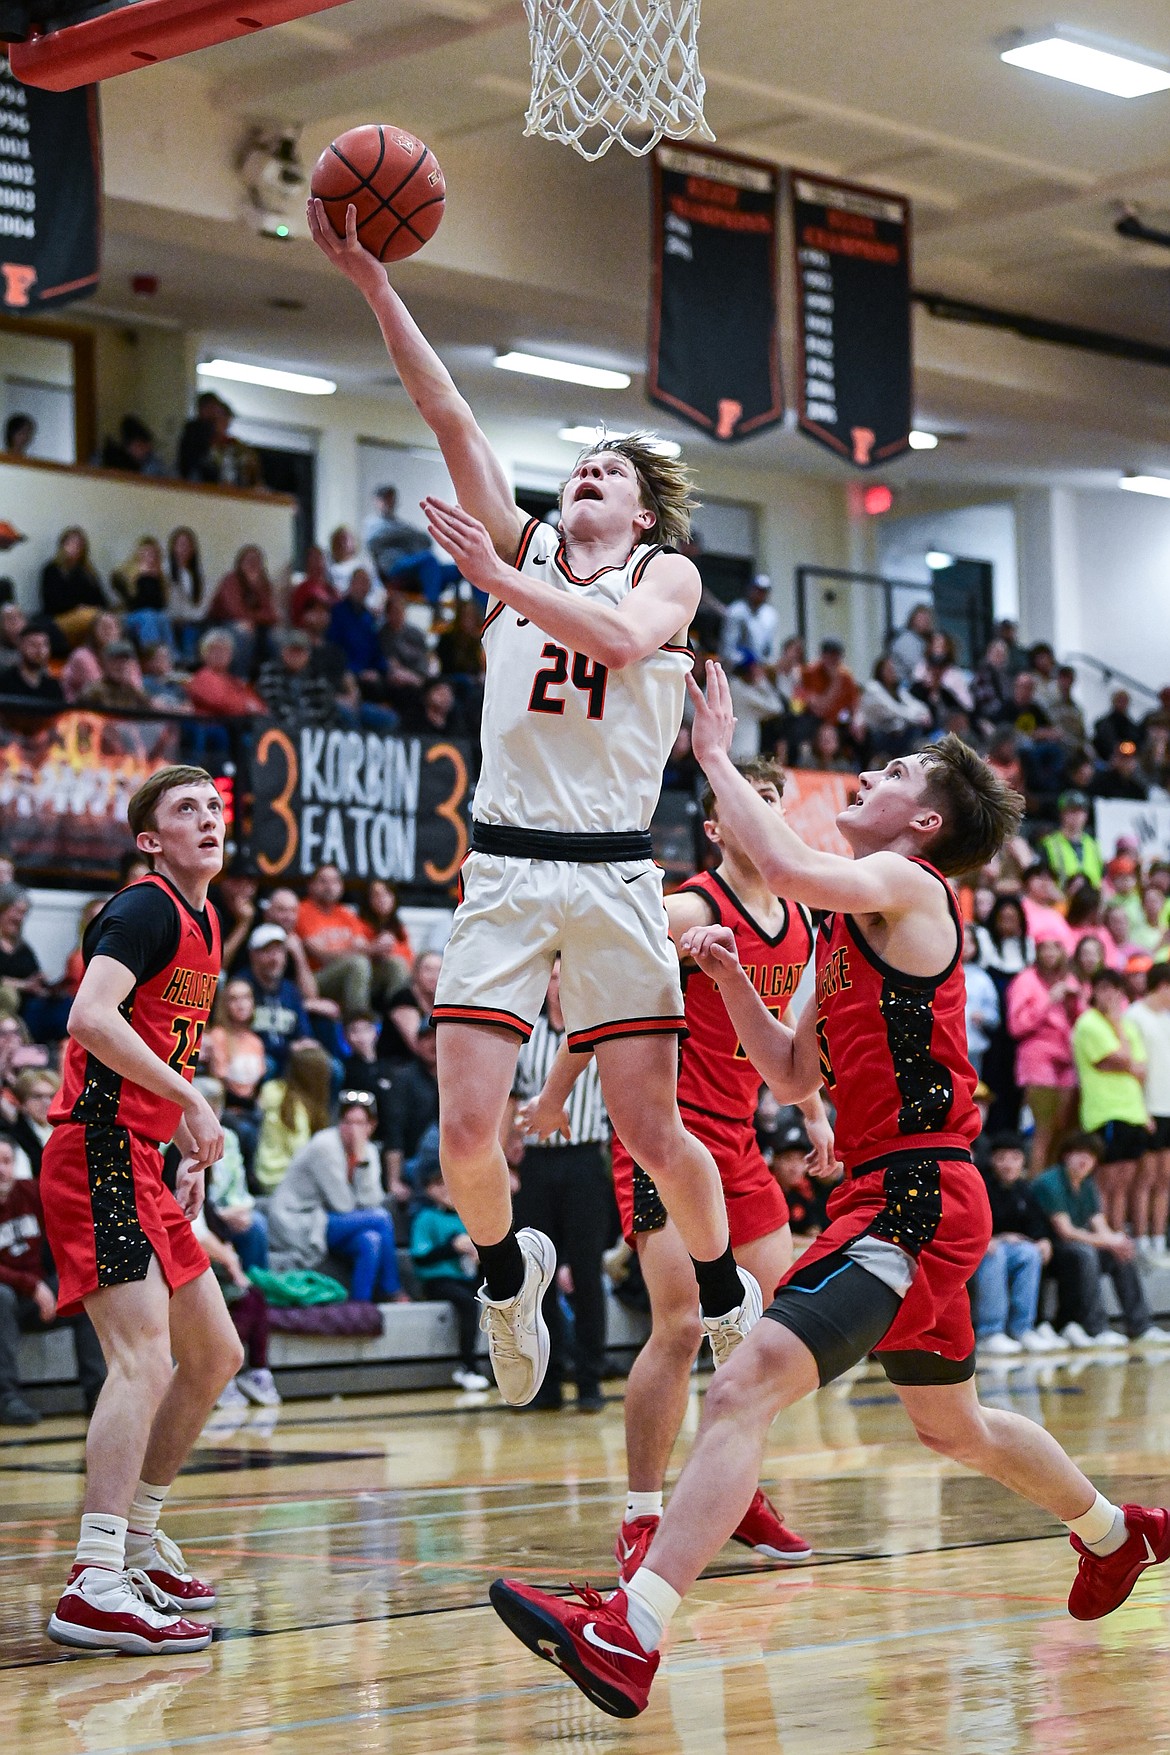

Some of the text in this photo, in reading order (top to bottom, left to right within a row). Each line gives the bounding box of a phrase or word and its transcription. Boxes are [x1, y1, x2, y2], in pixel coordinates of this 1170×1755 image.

[527, 642, 608, 720] 24
[257, 728, 298, 876] 3
[300, 727, 421, 813] KORBIN
[300, 804, 417, 883] EATON
[424, 743, 468, 884] 3
